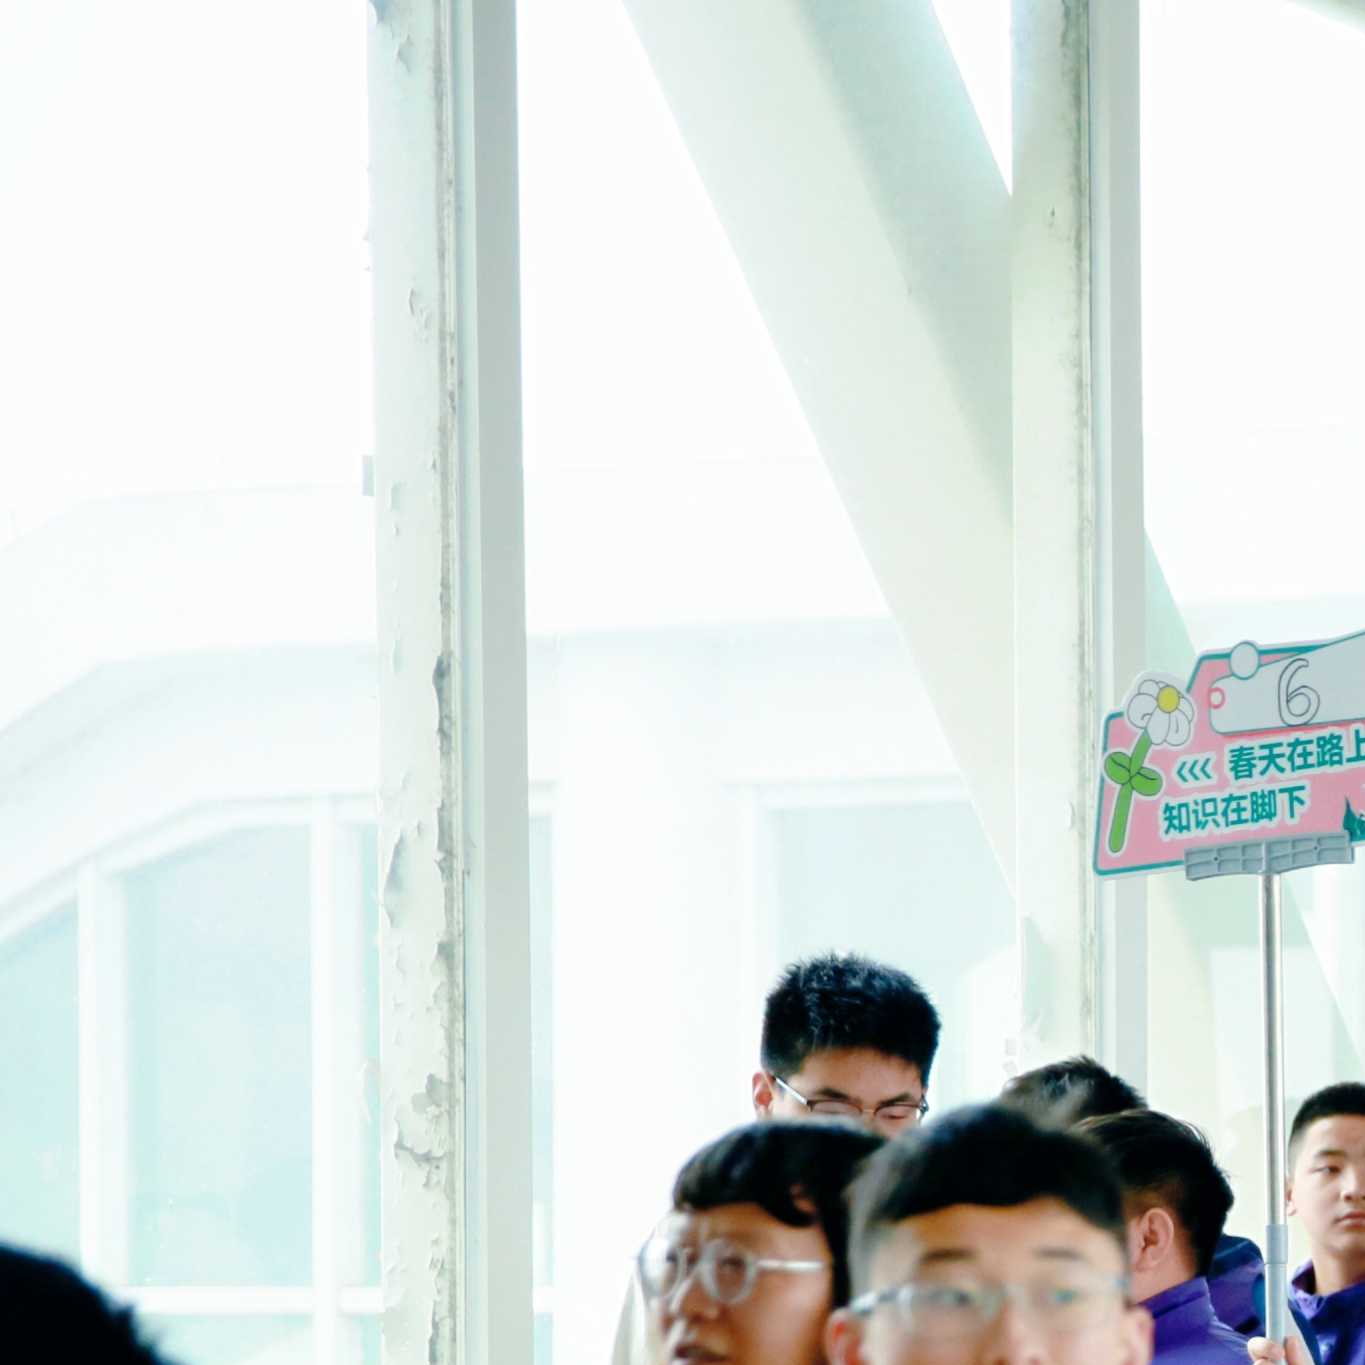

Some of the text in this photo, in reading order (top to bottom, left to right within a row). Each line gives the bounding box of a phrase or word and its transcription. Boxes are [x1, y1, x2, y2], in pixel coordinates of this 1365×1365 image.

[1277, 657, 1321, 728] 6
[1162, 784, 1307, 835] 知识在脚下
